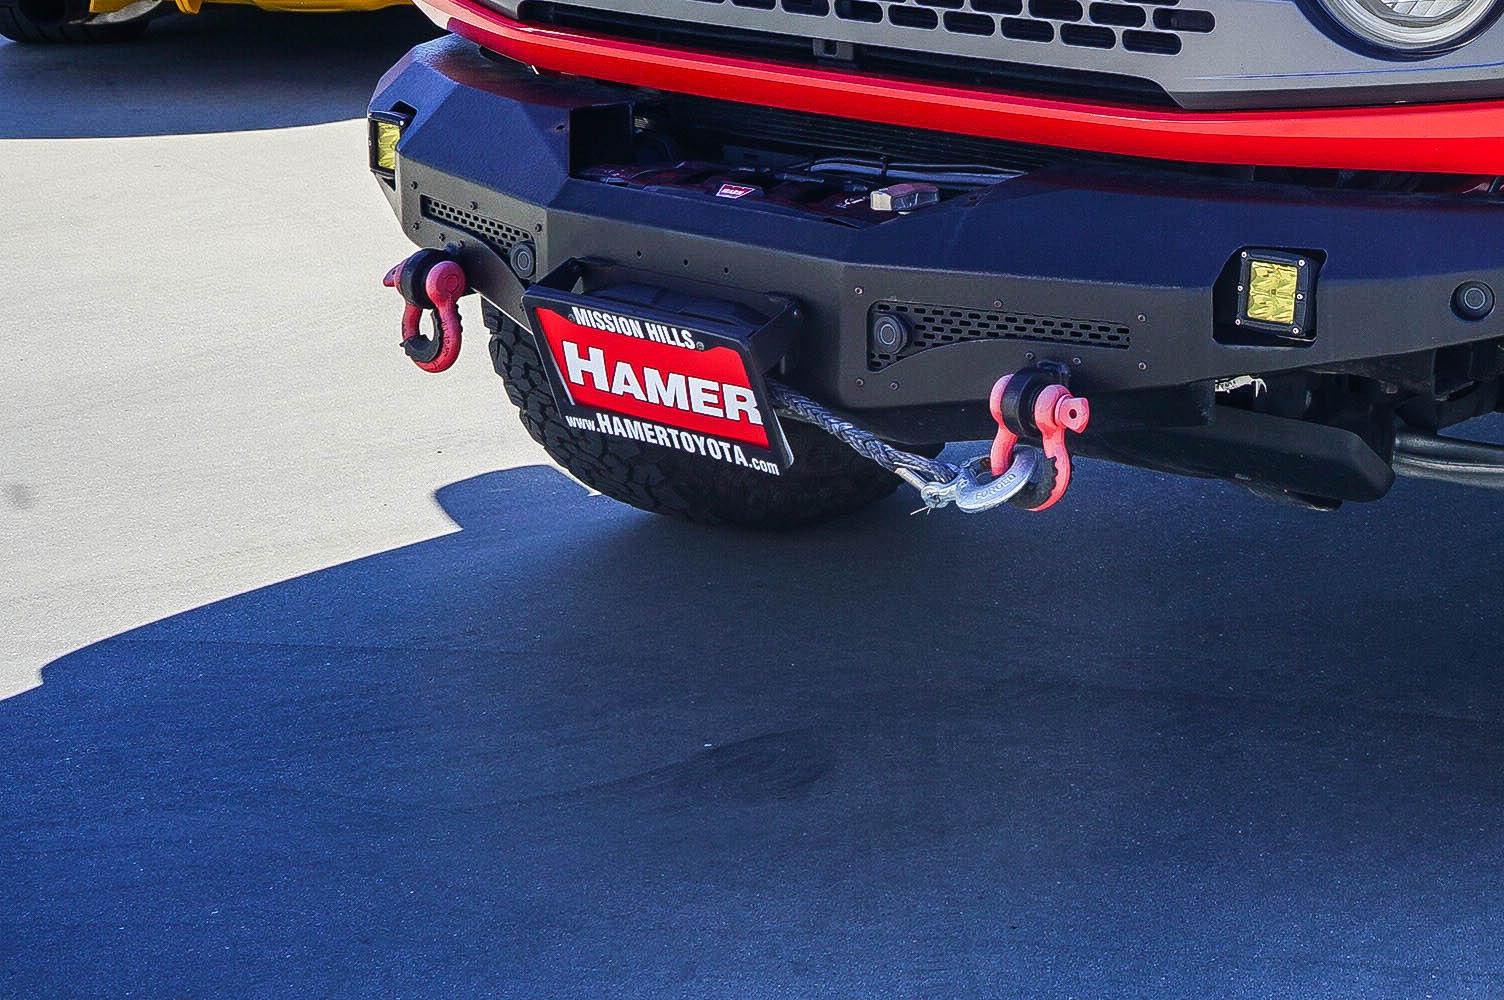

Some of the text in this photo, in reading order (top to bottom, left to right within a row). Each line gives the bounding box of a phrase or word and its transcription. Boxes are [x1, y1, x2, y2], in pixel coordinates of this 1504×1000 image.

[572, 306, 696, 350] MISSION HILLS
[562, 340, 764, 426] HAMER
[565, 412, 781, 476] www.HAMERTOYOTA.com
[975, 473, 1017, 500] FORGED
